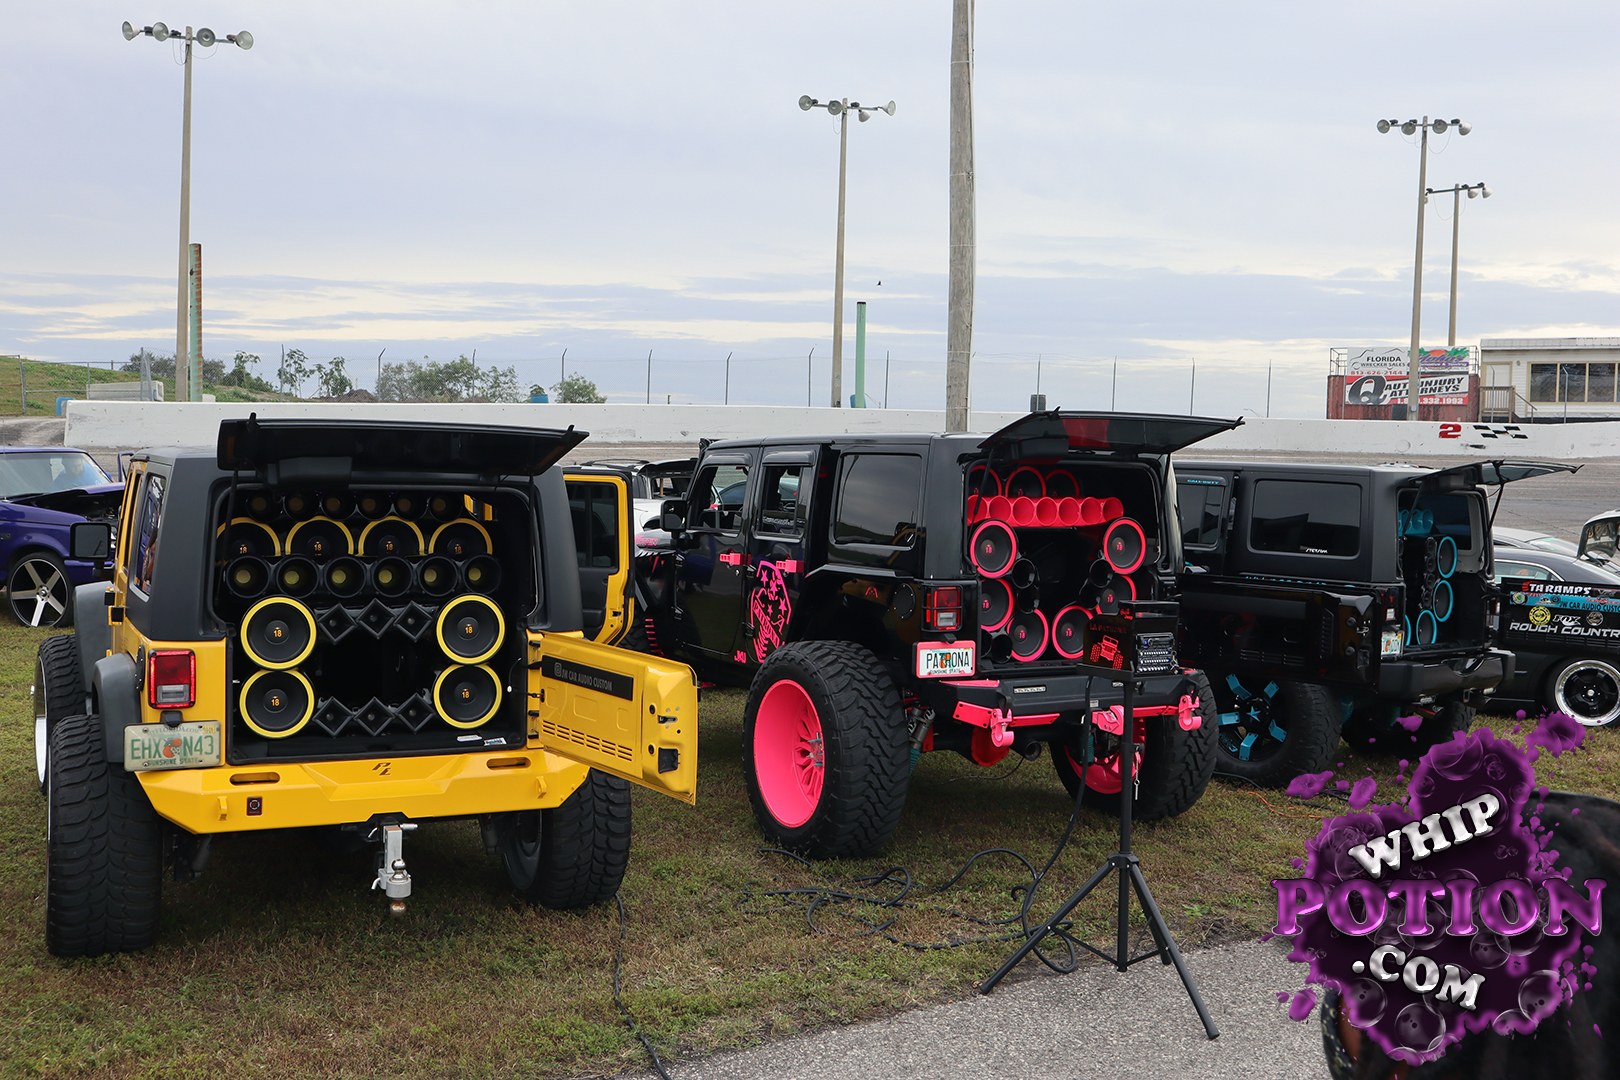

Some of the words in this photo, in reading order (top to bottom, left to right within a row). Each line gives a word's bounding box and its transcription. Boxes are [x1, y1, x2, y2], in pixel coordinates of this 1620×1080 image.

[1385, 382, 1409, 390] AUT
[1419, 377, 1464, 388] INJURY
[1389, 385, 1460, 397] ATTRNEYS
[1438, 423, 1462, 438] 2
[1529, 583, 1592, 595] TARAMPS
[273, 630, 282, 638] 18
[1509, 622, 1558, 634] ROUGH
[926, 651, 970, 669] PATRONA
[568, 671, 577, 682] CAR
[578, 674, 593, 686] AUDIO
[271, 698, 280, 707] 18
